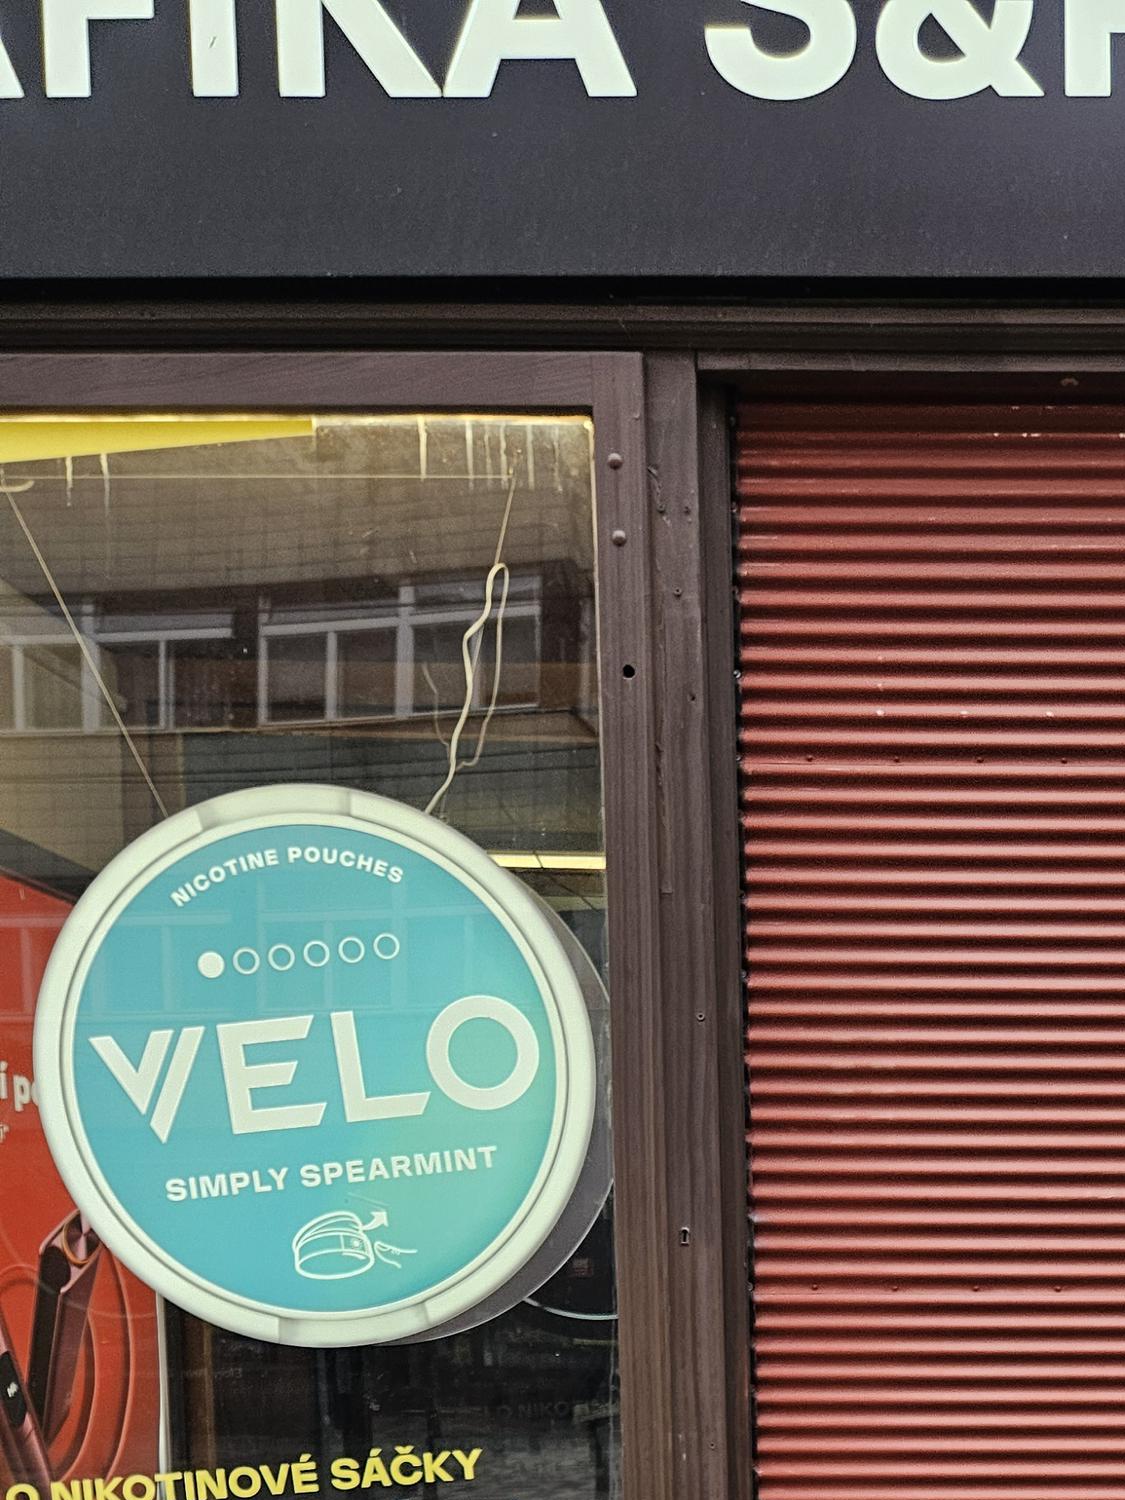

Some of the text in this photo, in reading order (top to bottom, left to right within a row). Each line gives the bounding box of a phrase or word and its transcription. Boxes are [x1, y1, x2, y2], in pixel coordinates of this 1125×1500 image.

[0, 0, 638, 98] FIKA
[170, 846, 404, 907] NICOTINE POUCHES
[88, 994, 540, 1144] VELO
[165, 1146, 498, 1202] SIMPLY SPEARMINT
[330, 1445, 483, 1490] SÁČKY
